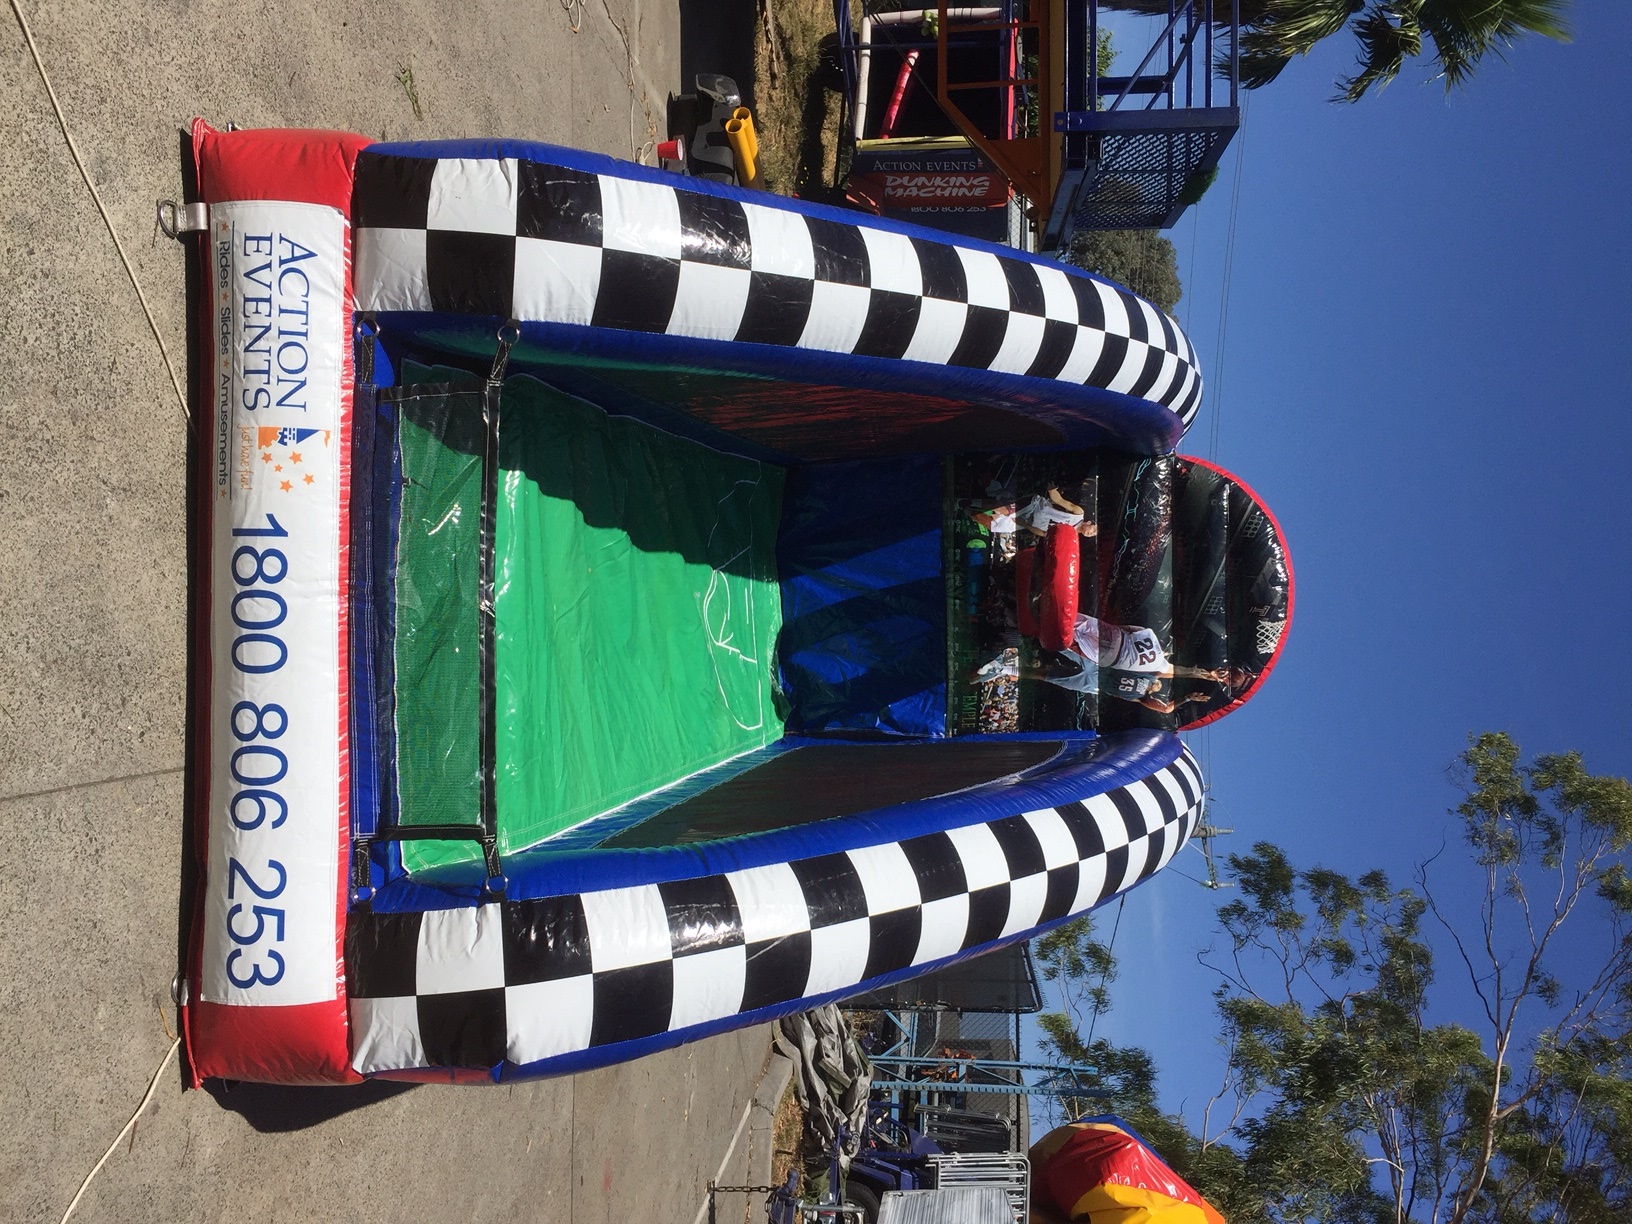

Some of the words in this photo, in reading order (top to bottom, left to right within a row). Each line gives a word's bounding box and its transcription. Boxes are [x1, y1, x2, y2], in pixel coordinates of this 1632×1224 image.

[873, 160, 921, 171] ACTION
[926, 161, 976, 171] EVENTS
[886, 175, 989, 186] DUNKING
[885, 187, 987, 197] MACHINE
[219, 241, 231, 289] Rides
[219, 306, 231, 356] Slides
[242, 231, 273, 411] EVENTS
[276, 232, 318, 412] ACTION
[219, 373, 230, 486] Amusements
[230, 513, 289, 674] 1800
[1134, 637, 1156, 666] 22
[1118, 677, 1135, 692] 35
[230, 701, 289, 831] 806
[226, 857, 289, 989] 253
